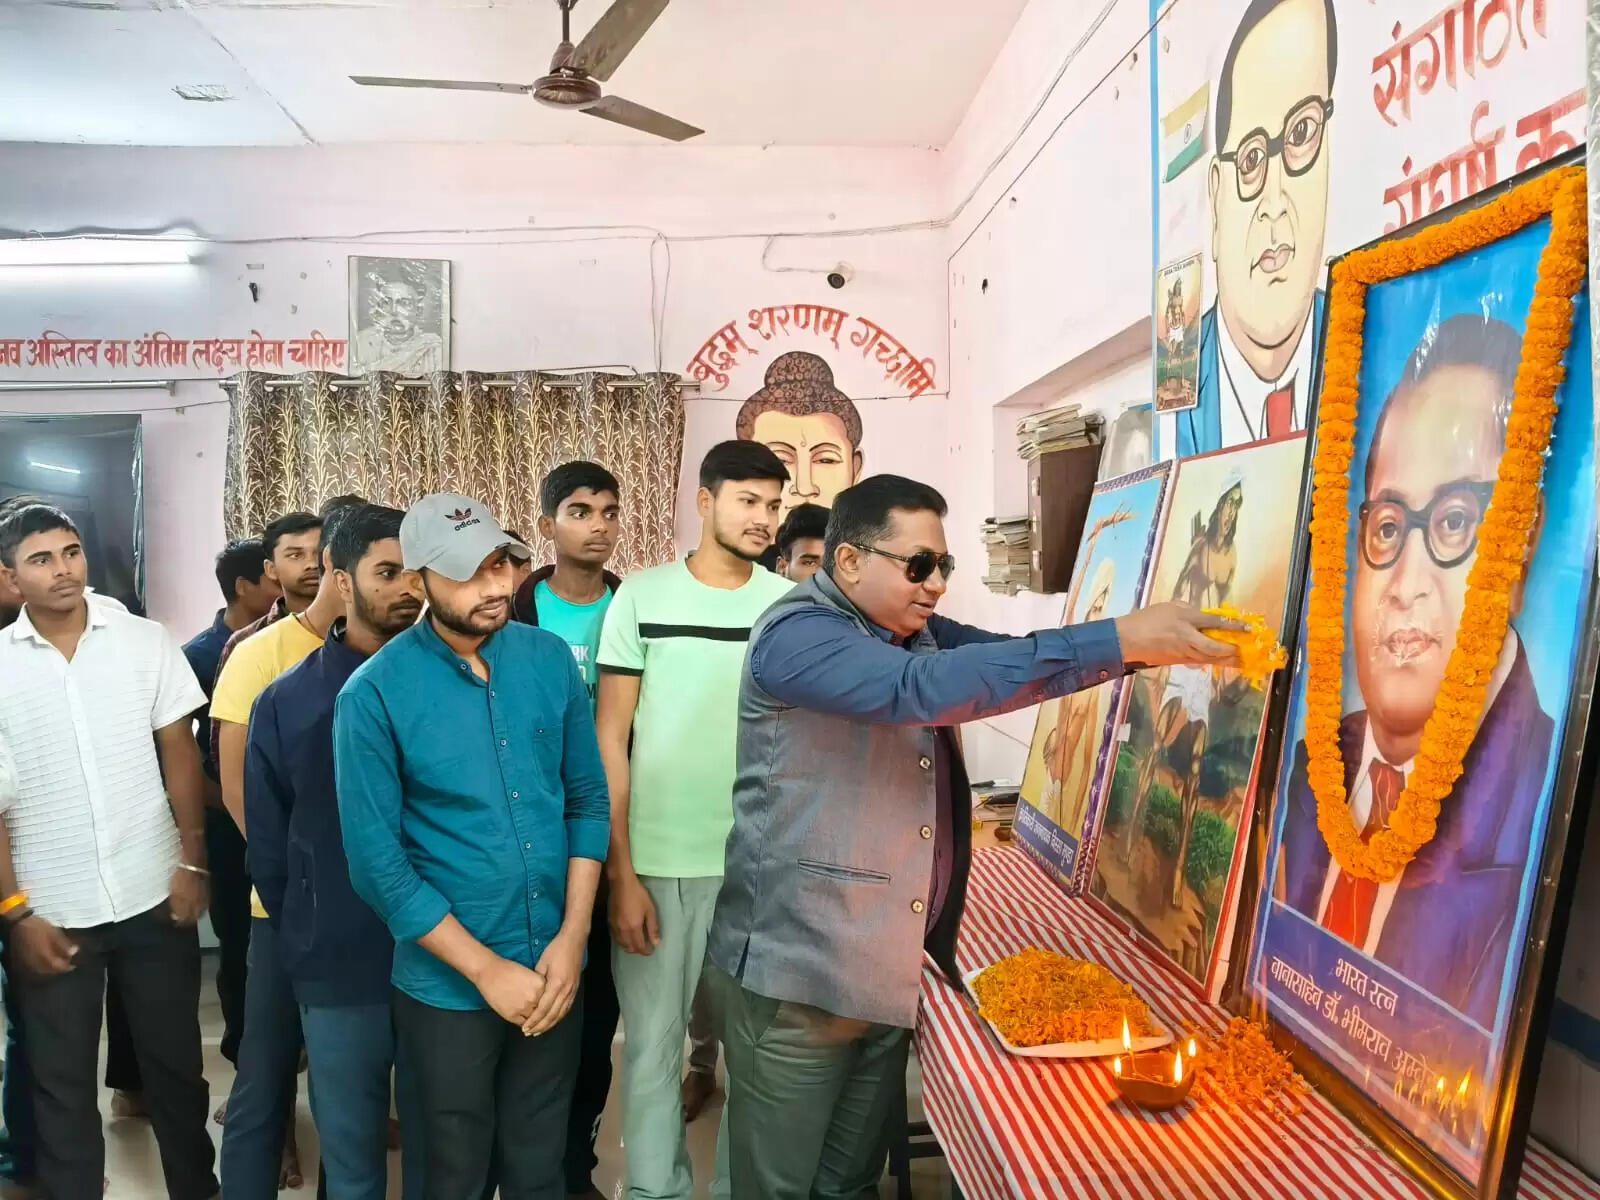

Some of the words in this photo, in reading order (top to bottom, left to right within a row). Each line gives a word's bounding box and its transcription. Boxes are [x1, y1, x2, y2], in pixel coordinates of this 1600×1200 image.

[104, 340, 131, 368] का
[132, 331, 190, 368] अंतिम
[246, 329, 285, 370] होना
[287, 329, 348, 371] चाहिए
[1335, 957, 1369, 997] भारत
[1369, 979, 1399, 1017] रत्न
[1341, 1004, 1393, 1063] भीमराव
